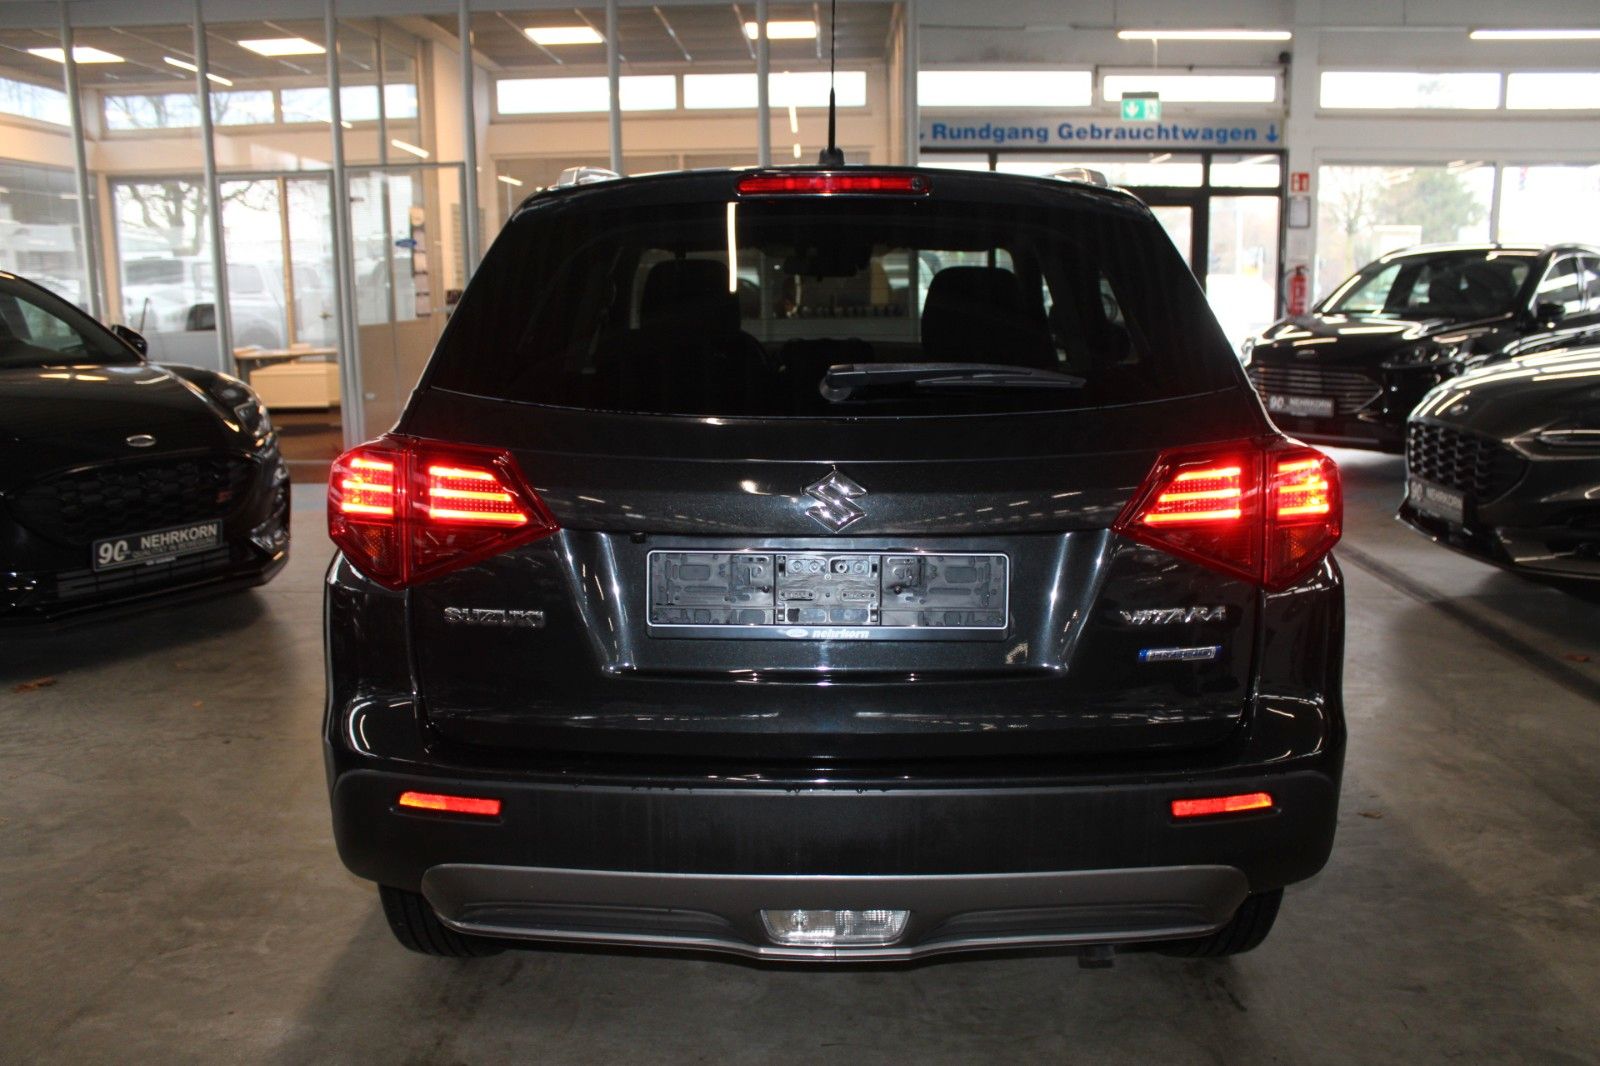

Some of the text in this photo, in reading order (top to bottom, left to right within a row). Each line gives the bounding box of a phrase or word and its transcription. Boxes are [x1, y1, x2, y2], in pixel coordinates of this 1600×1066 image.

[931, 122, 1258, 144] Rundgang Gebrauchtwagen
[140, 523, 218, 550] NEHRKORN
[812, 628, 870, 639] nehrkorn
